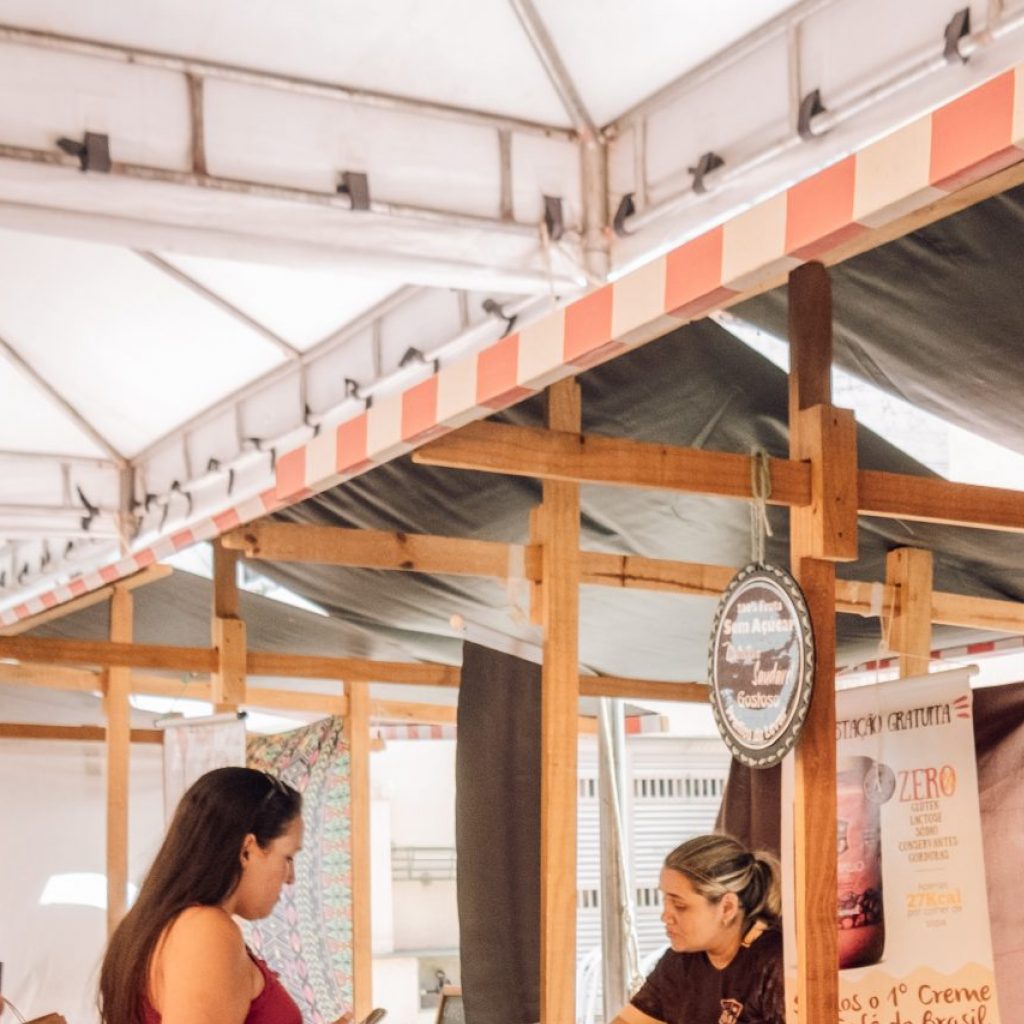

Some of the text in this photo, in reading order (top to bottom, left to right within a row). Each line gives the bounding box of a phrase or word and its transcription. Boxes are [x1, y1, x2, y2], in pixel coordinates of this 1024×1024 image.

[723, 618, 750, 635] Sem
[888, 703, 951, 731] GRATUITA
[899, 765, 956, 803] ZERO
[869, 995, 879, 1009] o
[918, 984, 991, 1006] Creme
